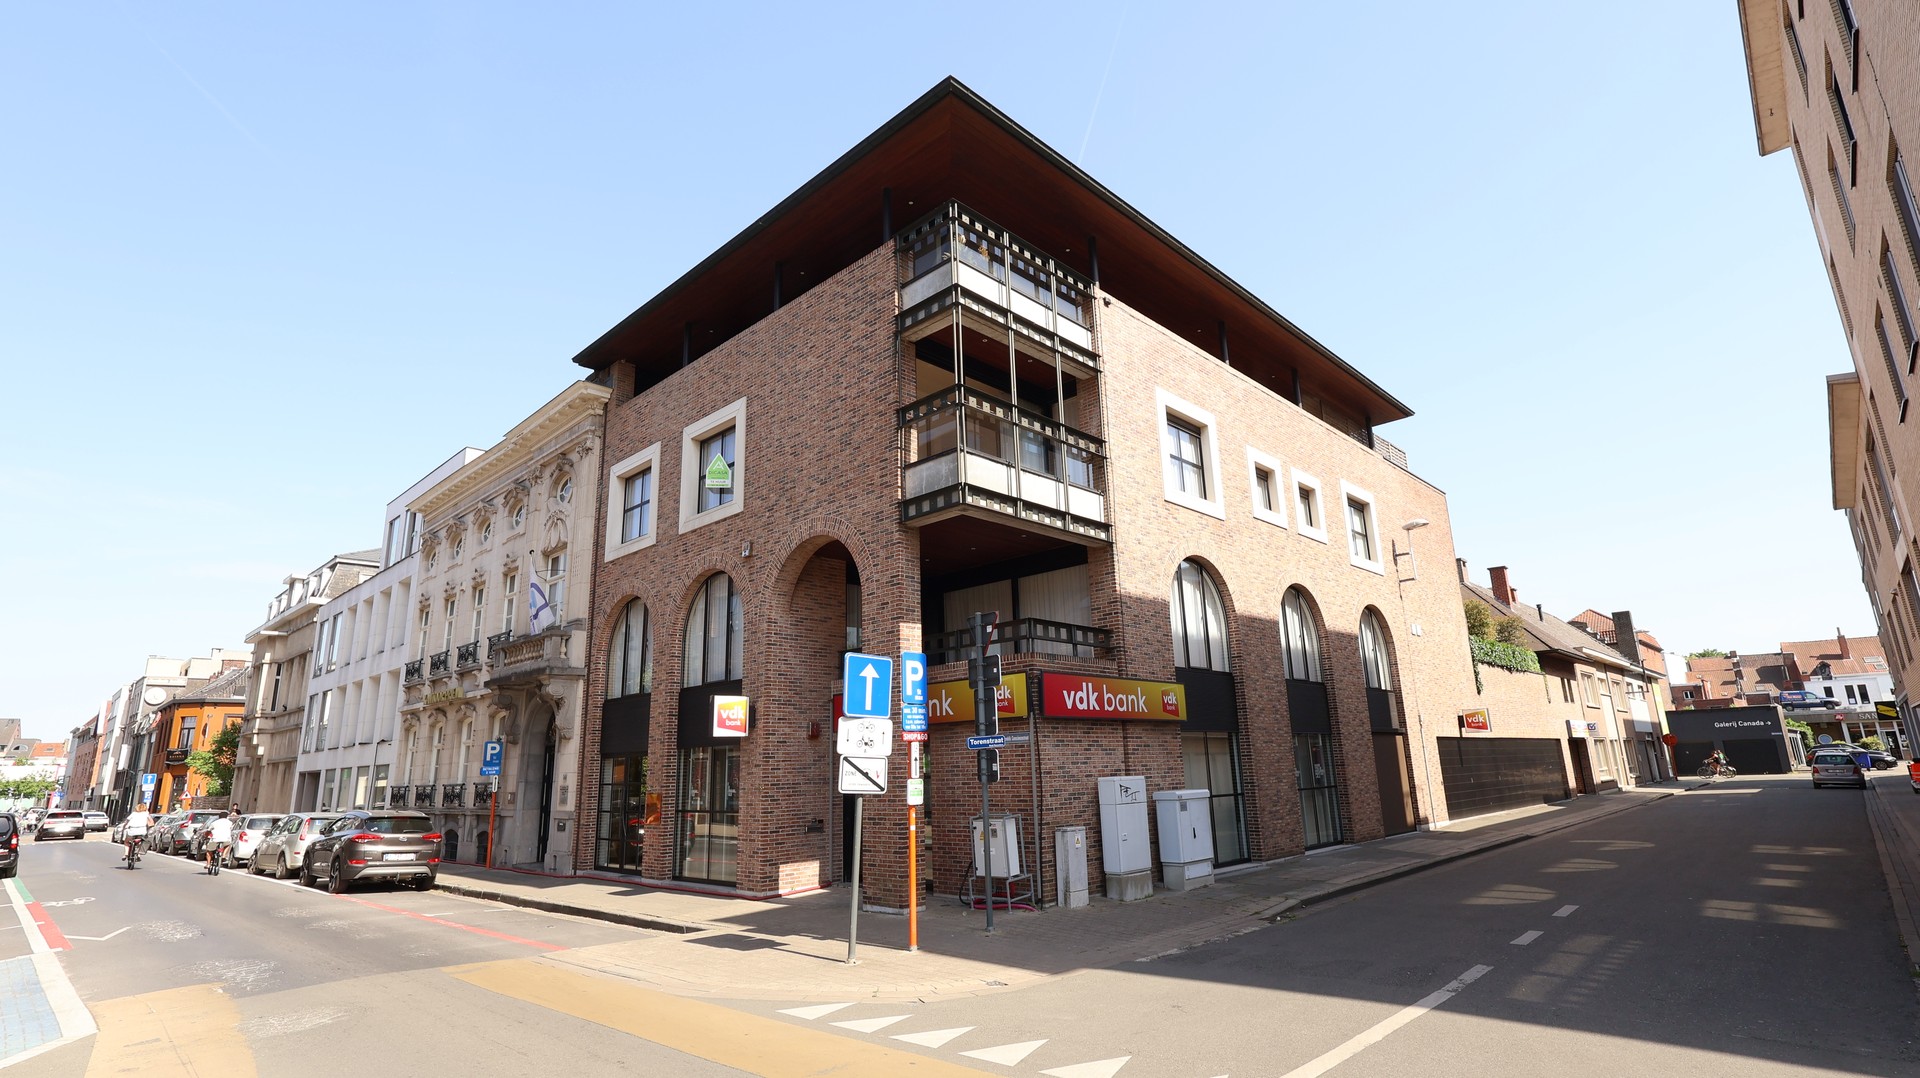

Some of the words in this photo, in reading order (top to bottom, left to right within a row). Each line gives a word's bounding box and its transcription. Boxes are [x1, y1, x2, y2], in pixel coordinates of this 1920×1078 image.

[905, 660, 923, 696] P
[996, 685, 1012, 700] dk
[1063, 681, 1101, 711] vdk
[1103, 684, 1148, 713] bank
[1163, 692, 1178, 705] vdk
[928, 689, 953, 717] nk
[720, 705, 745, 719] vdk
[969, 737, 1004, 745] Torenstraat
[486, 743, 501, 761] P
